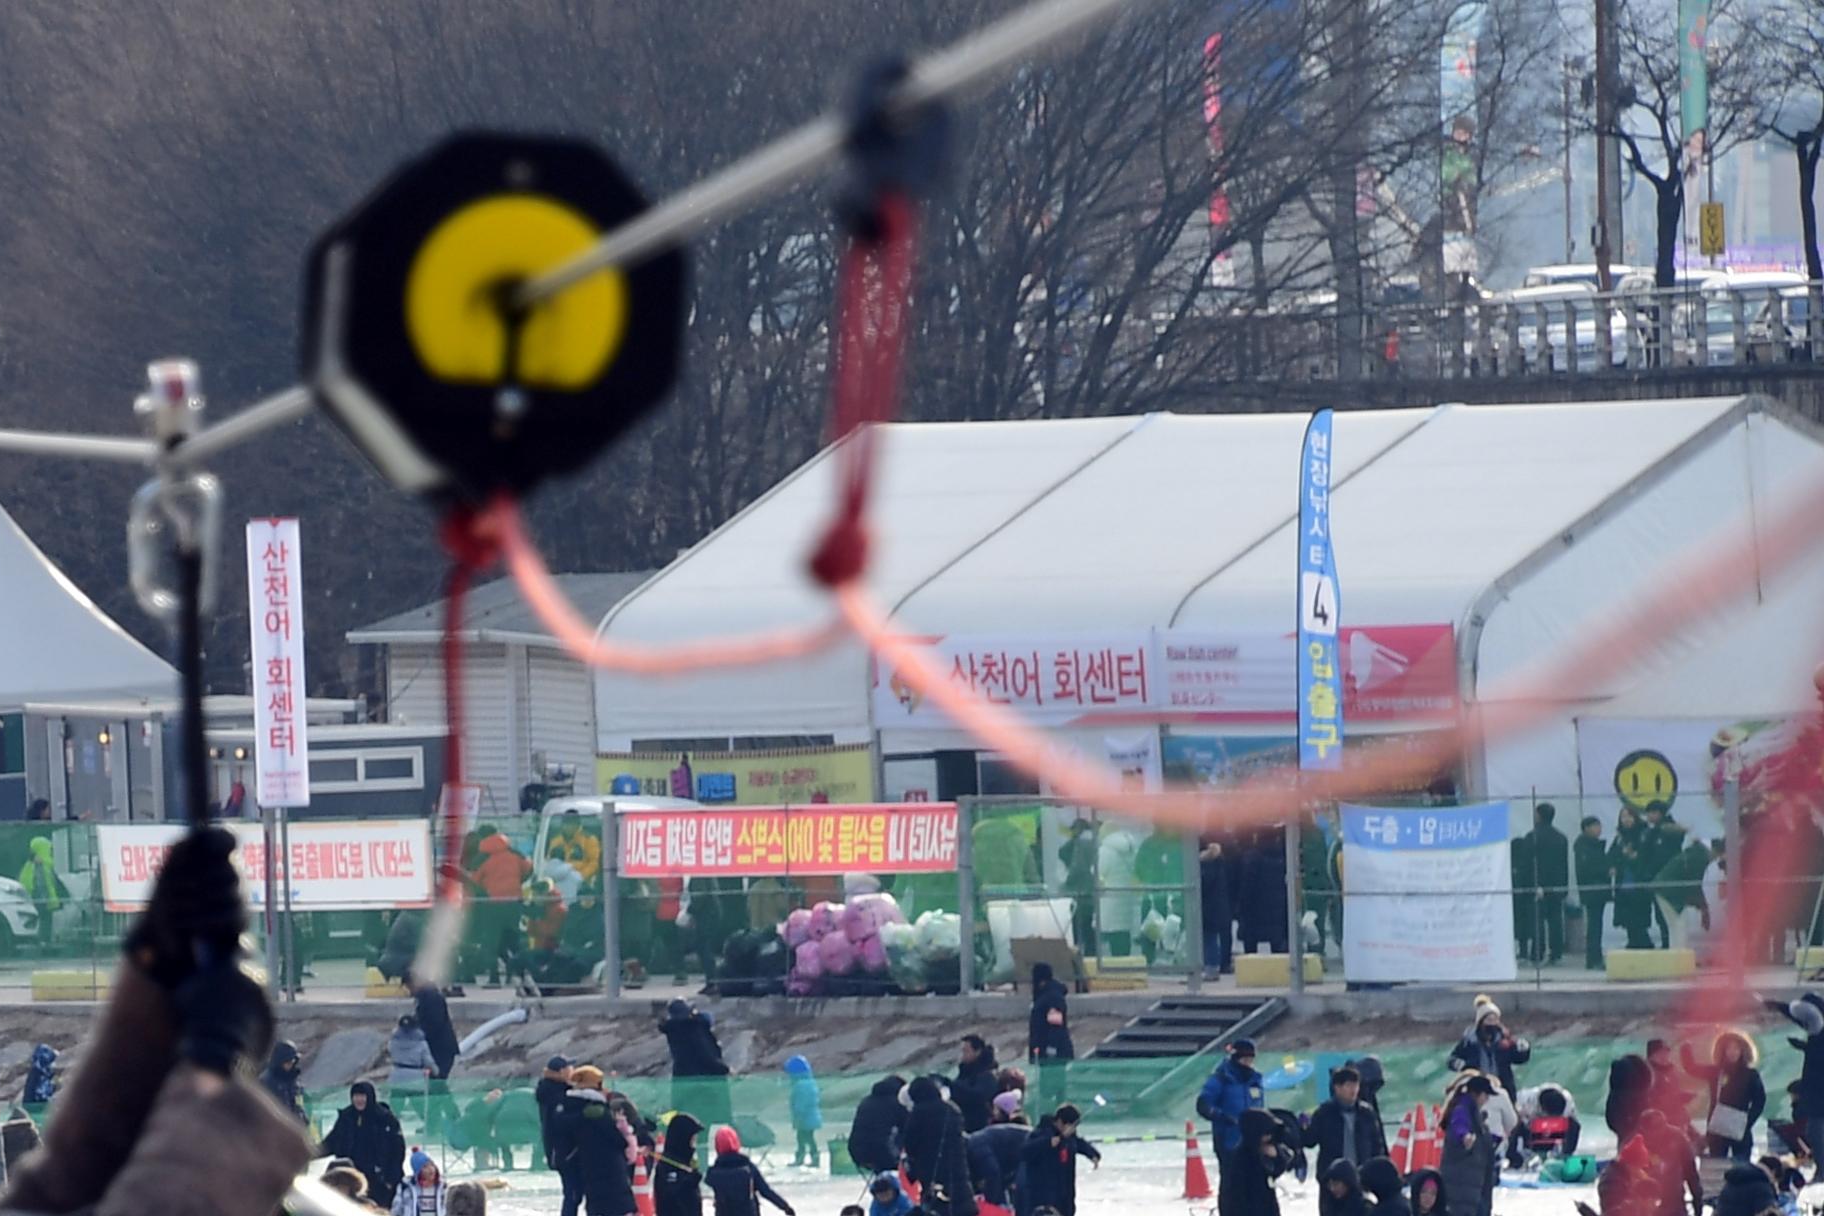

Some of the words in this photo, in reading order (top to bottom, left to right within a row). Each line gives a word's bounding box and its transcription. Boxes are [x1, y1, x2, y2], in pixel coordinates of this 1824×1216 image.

[262, 540, 289, 640] 산천어
[1312, 580, 1328, 627] 4
[265, 656, 295, 757] 회센터
[1053, 646, 1148, 704] 회센터
[1306, 641, 1341, 758] 입출구
